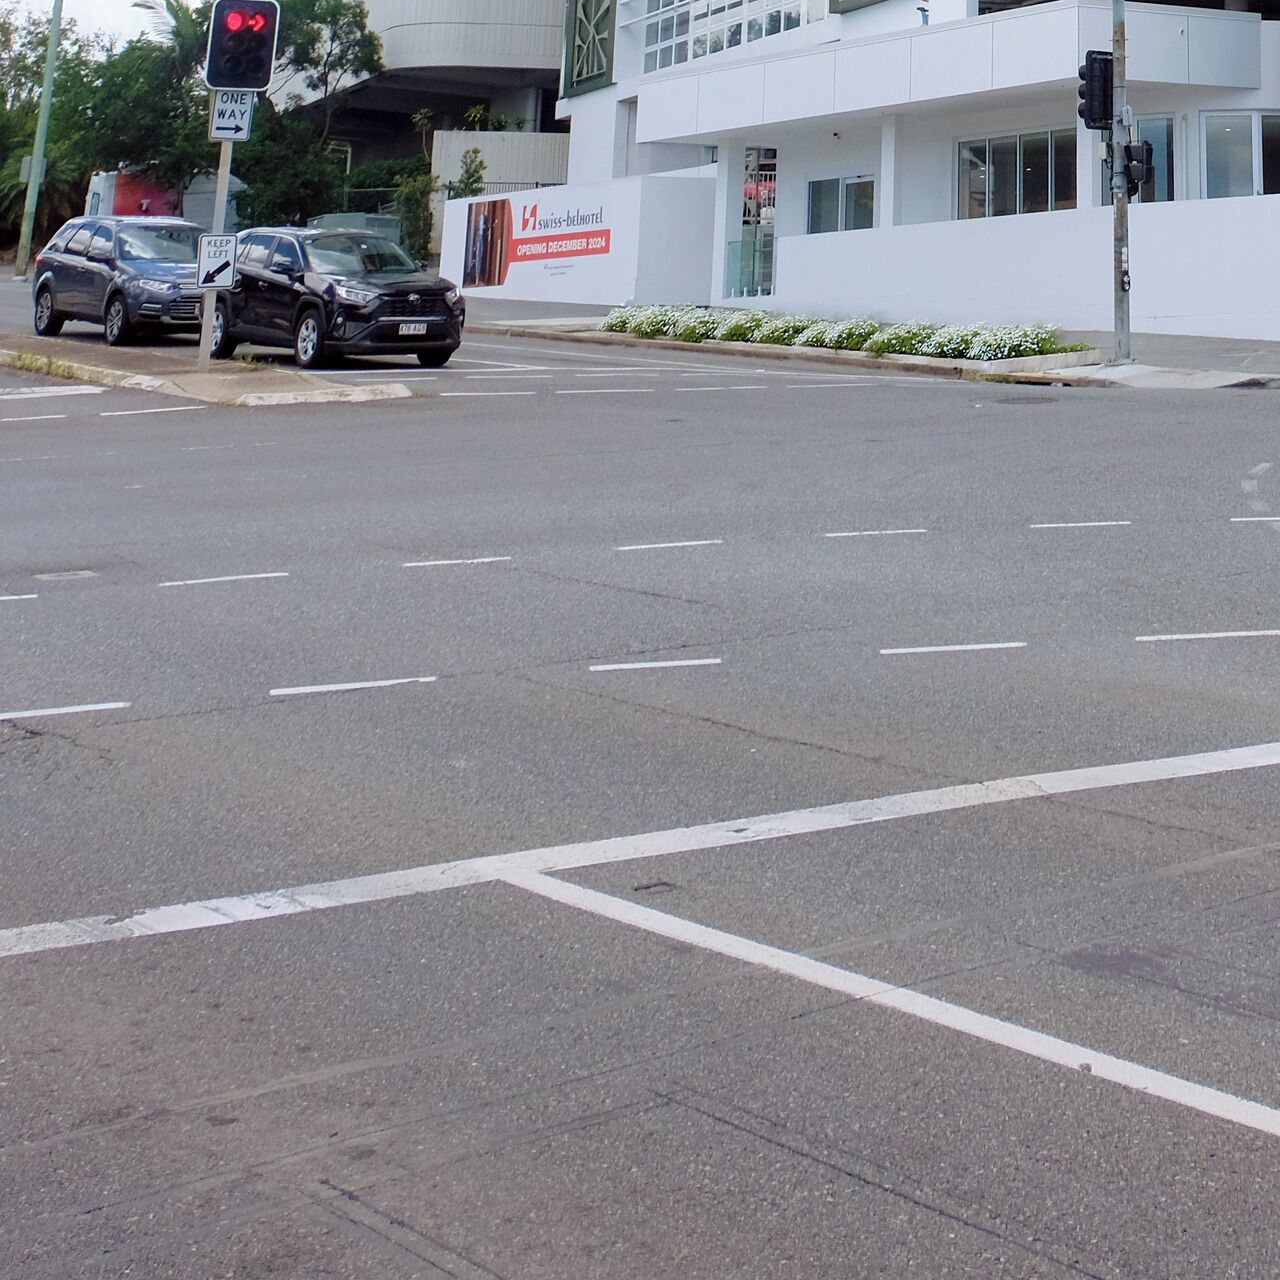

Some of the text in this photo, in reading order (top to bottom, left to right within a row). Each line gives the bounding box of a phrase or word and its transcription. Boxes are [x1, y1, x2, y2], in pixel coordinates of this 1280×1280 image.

[221, 92, 247, 105] ONE
[217, 108, 248, 120] WAY
[207, 239, 231, 248] KEEP
[516, 237, 605, 256] OPENING DECEMBER 2024
[207, 250, 229, 259] LEFT
